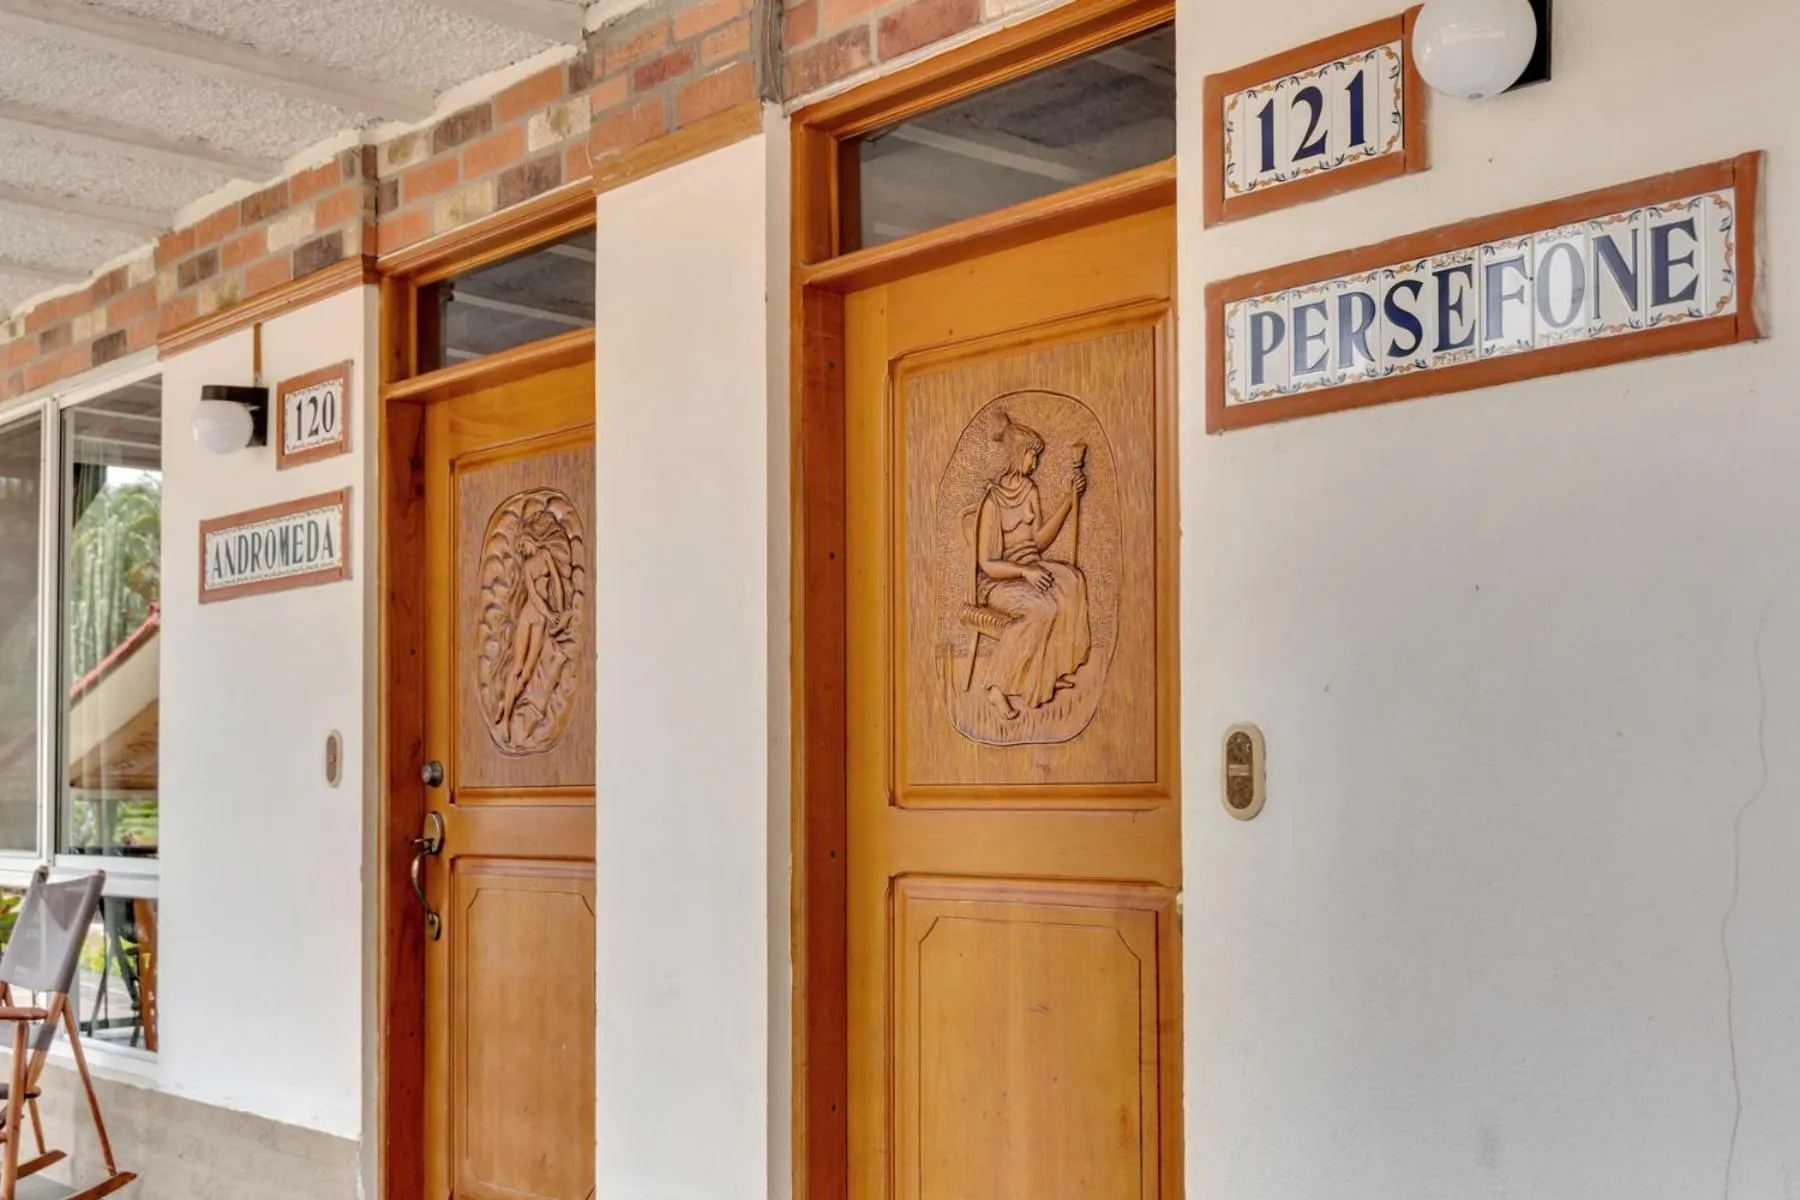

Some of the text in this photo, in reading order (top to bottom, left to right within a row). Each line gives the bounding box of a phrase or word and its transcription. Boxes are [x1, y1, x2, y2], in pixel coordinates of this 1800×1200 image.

[1256, 69, 1366, 173] 121
[1249, 217, 1700, 386] PERSEFONE
[296, 391, 335, 441] 120
[213, 518, 334, 579] ANDROMEDA
